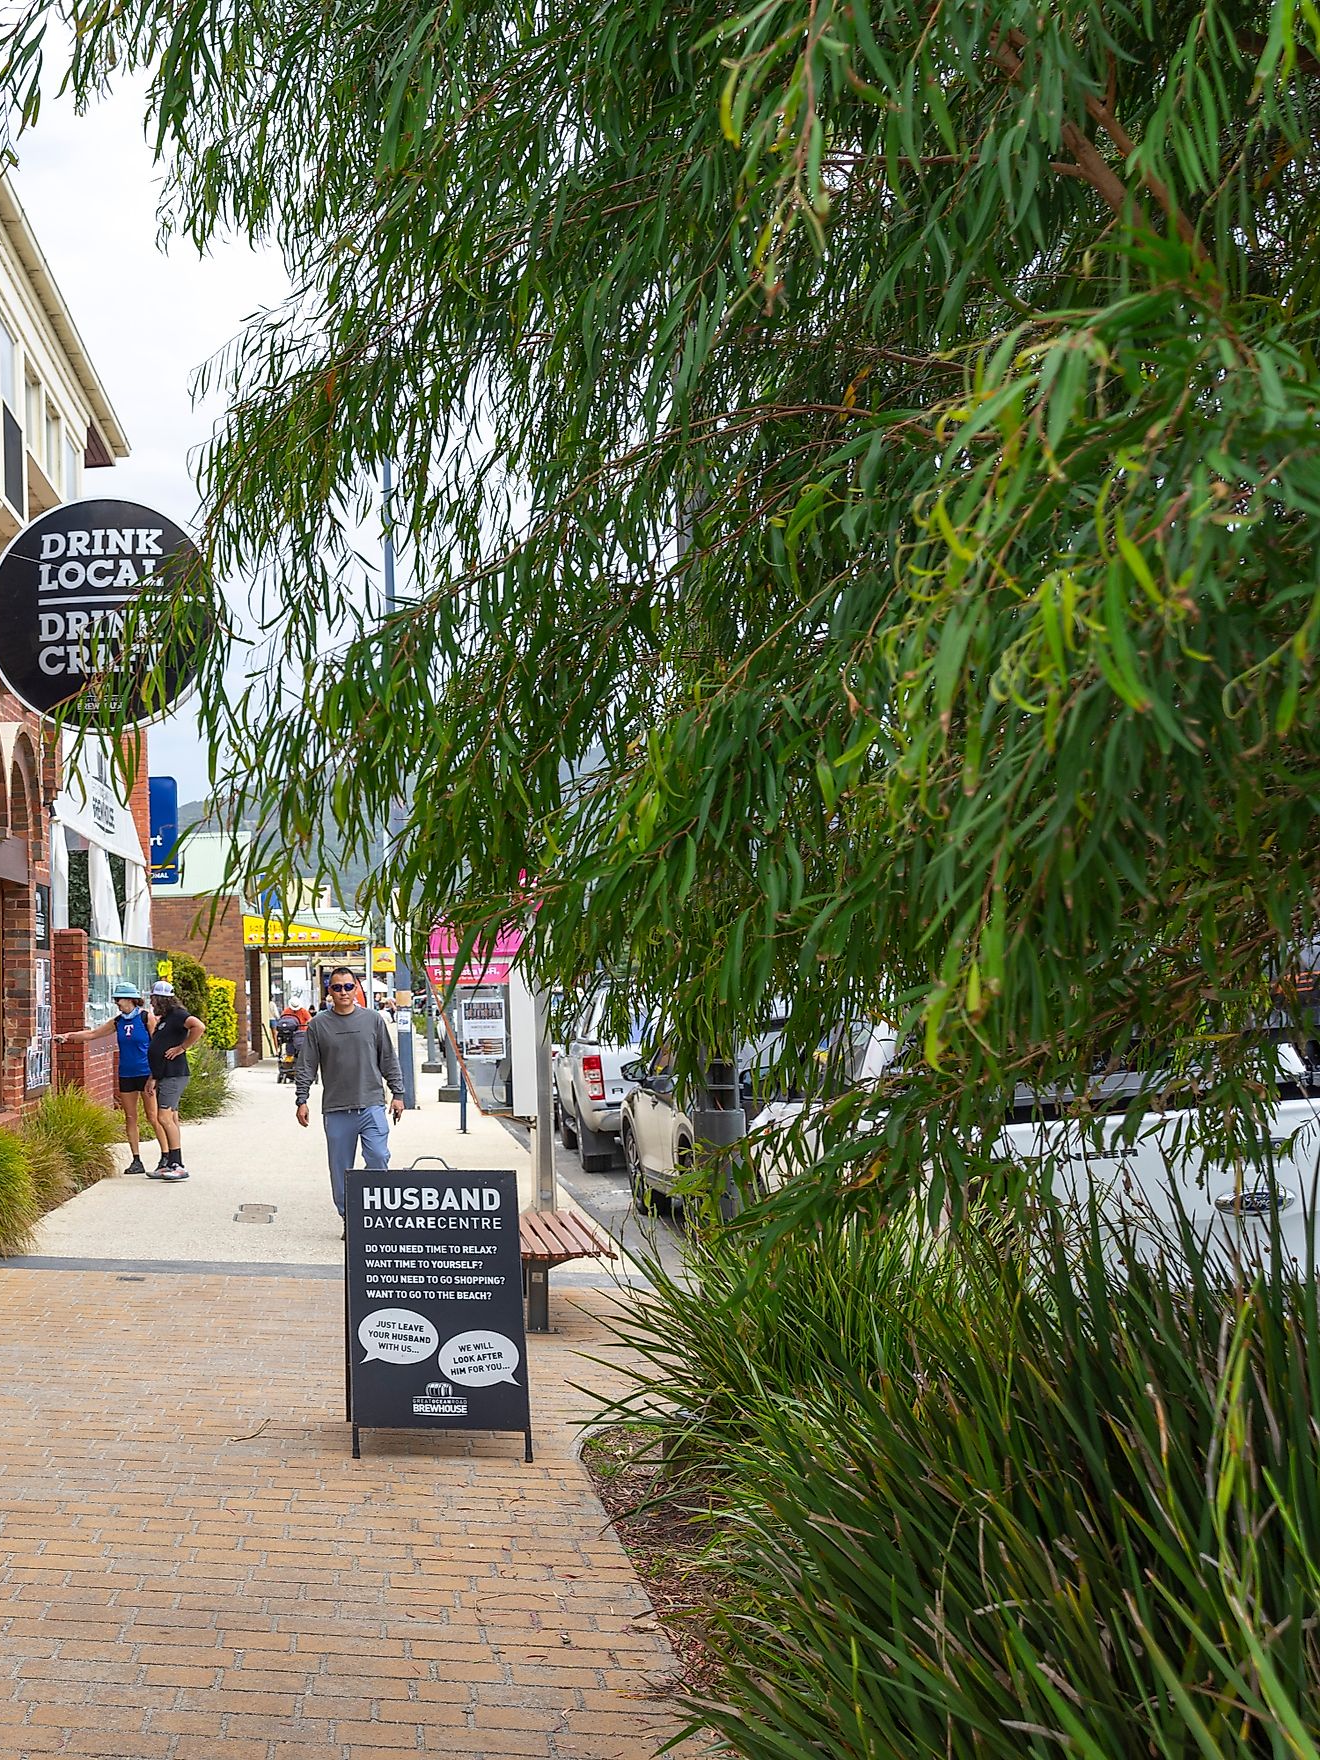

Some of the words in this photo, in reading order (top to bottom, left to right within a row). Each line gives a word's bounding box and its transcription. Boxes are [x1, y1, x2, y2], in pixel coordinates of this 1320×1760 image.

[40, 528, 163, 560] DRINK
[38, 559, 164, 591] LOCAL
[434, 968, 451, 976] Fre
[363, 1187, 501, 1211] HUSBAND
[363, 1216, 502, 1230] DAYCARECENTRE
[365, 1244, 378, 1253] DO
[379, 1245, 397, 1253] YOU
[399, 1245, 424, 1253] NEED
[425, 1245, 447, 1253] TIME
[448, 1245, 460, 1253] TO
[462, 1246, 498, 1254] RELAX?
[365, 1259, 392, 1268] WANT
[394, 1260, 416, 1268] TIME
[417, 1260, 430, 1269] TO
[431, 1260, 483, 1269] YOURSELF?
[366, 1275, 379, 1283] DO
[380, 1275, 398, 1283] YOU
[400, 1275, 425, 1284] NEED
[426, 1275, 438, 1284] TO
[440, 1276, 453, 1284] GO
[454, 1276, 506, 1285] SHOPPING?
[366, 1290, 394, 1298] WANT
[395, 1290, 407, 1298] TO
[409, 1290, 421, 1299] GO
[423, 1291, 435, 1299] TO
[437, 1291, 455, 1299] THE
[457, 1291, 492, 1300] BEACH?
[376, 1320, 396, 1329] JUST
[398, 1323, 424, 1332] LEAVE
[368, 1330, 390, 1339] YOUR
[391, 1333, 431, 1343] HUSBAND
[378, 1342, 399, 1351] WITH
[400, 1345, 420, 1354] US...
[458, 1344, 472, 1352] WE
[473, 1342, 494, 1350] WILL
[453, 1355, 475, 1364] LOOK
[476, 1352, 503, 1361] AFTER
[450, 1367, 466, 1375] HIM
[468, 1365, 484, 1373] FOR
[485, 1363, 510, 1371] YOU...
[412, 1404, 468, 1413] BREWHOUSE
